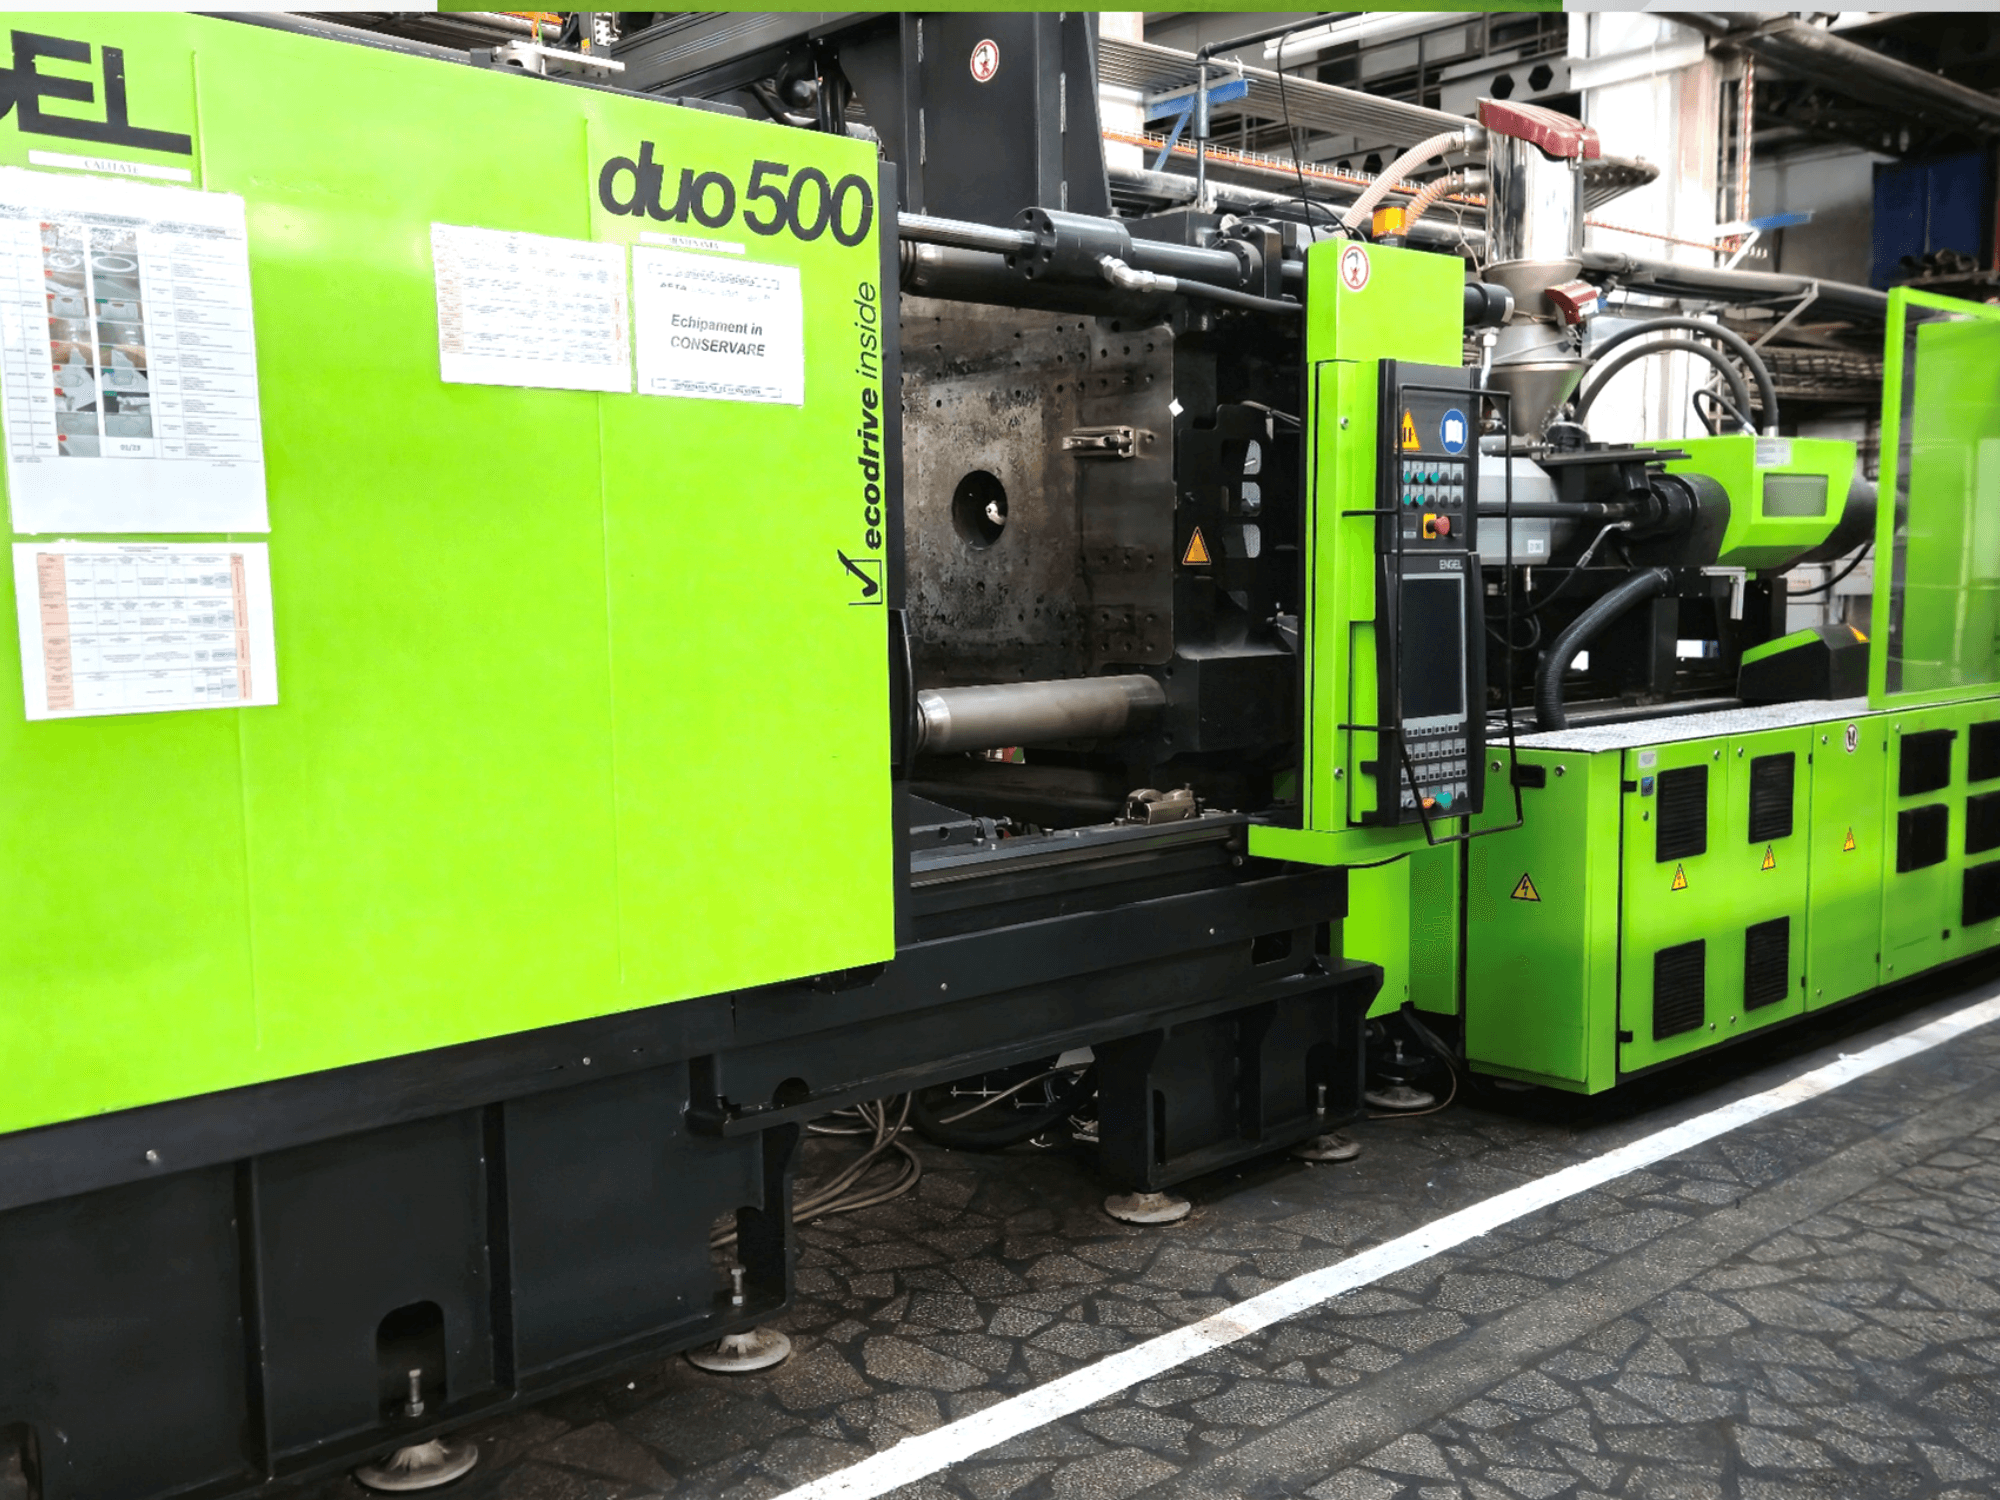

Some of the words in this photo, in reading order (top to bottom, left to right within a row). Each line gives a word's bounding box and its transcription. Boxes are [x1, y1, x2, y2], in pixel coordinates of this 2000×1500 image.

[599, 140, 736, 228] duo
[743, 159, 873, 247] 500
[671, 313, 748, 334] Echipament
[751, 322, 763, 336] in
[671, 335, 766, 358] CONSERVARE
[854, 281, 878, 380] inside
[857, 387, 882, 550] ecodrive
